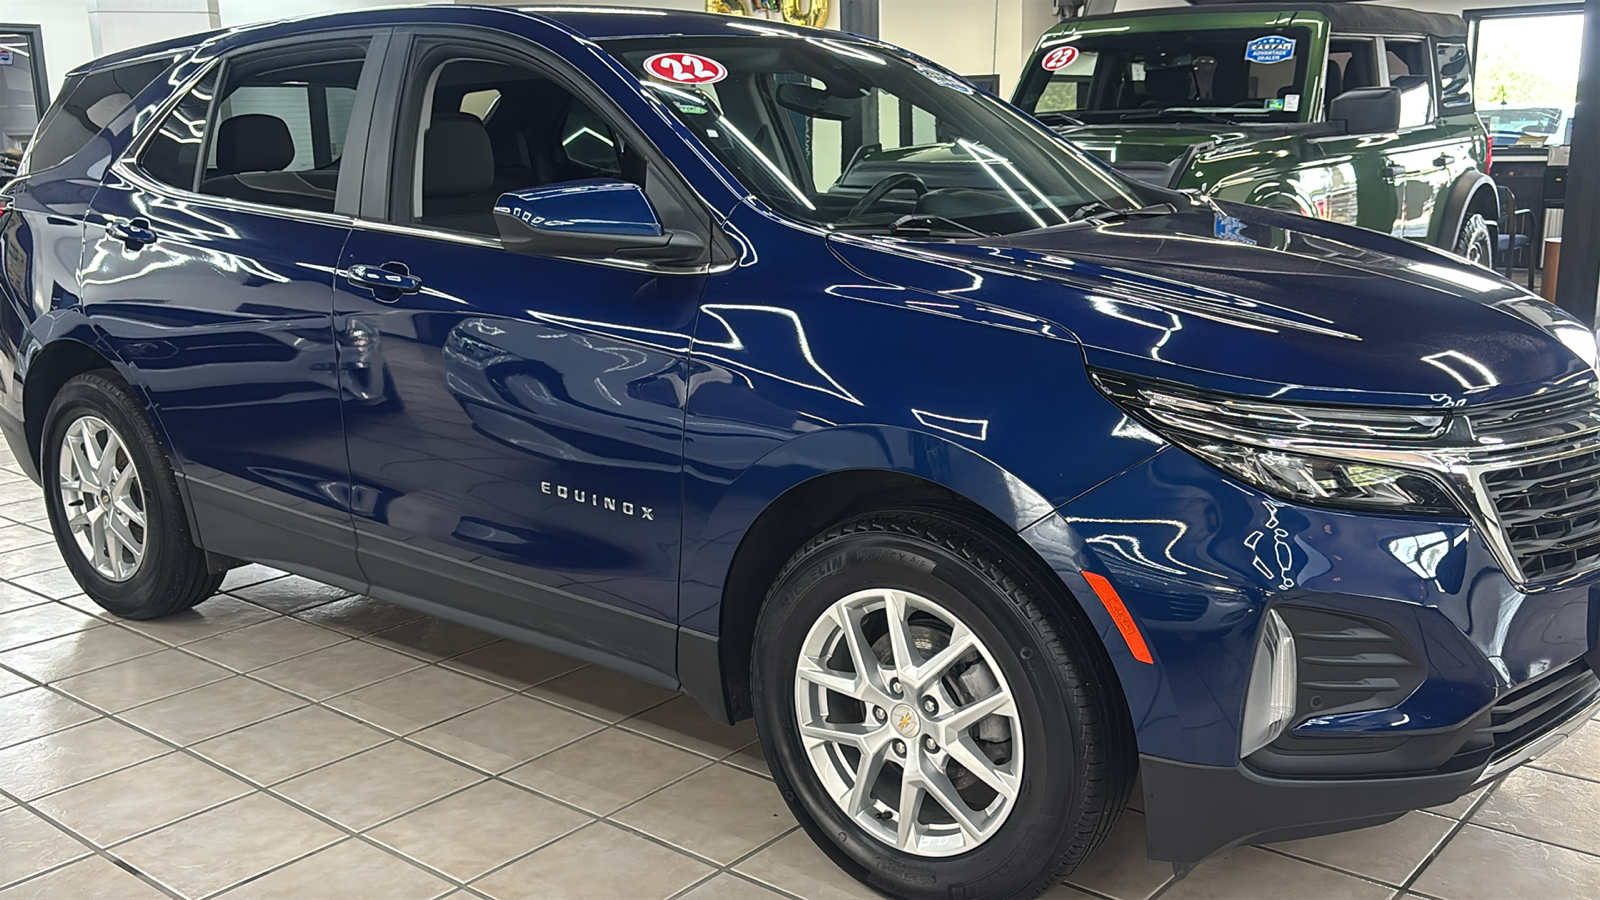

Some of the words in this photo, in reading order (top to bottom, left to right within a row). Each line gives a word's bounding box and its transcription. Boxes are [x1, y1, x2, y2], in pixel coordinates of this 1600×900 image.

[660, 55, 716, 80] 22
[1046, 49, 1073, 68] 23
[540, 481, 654, 521] EQUINOX
